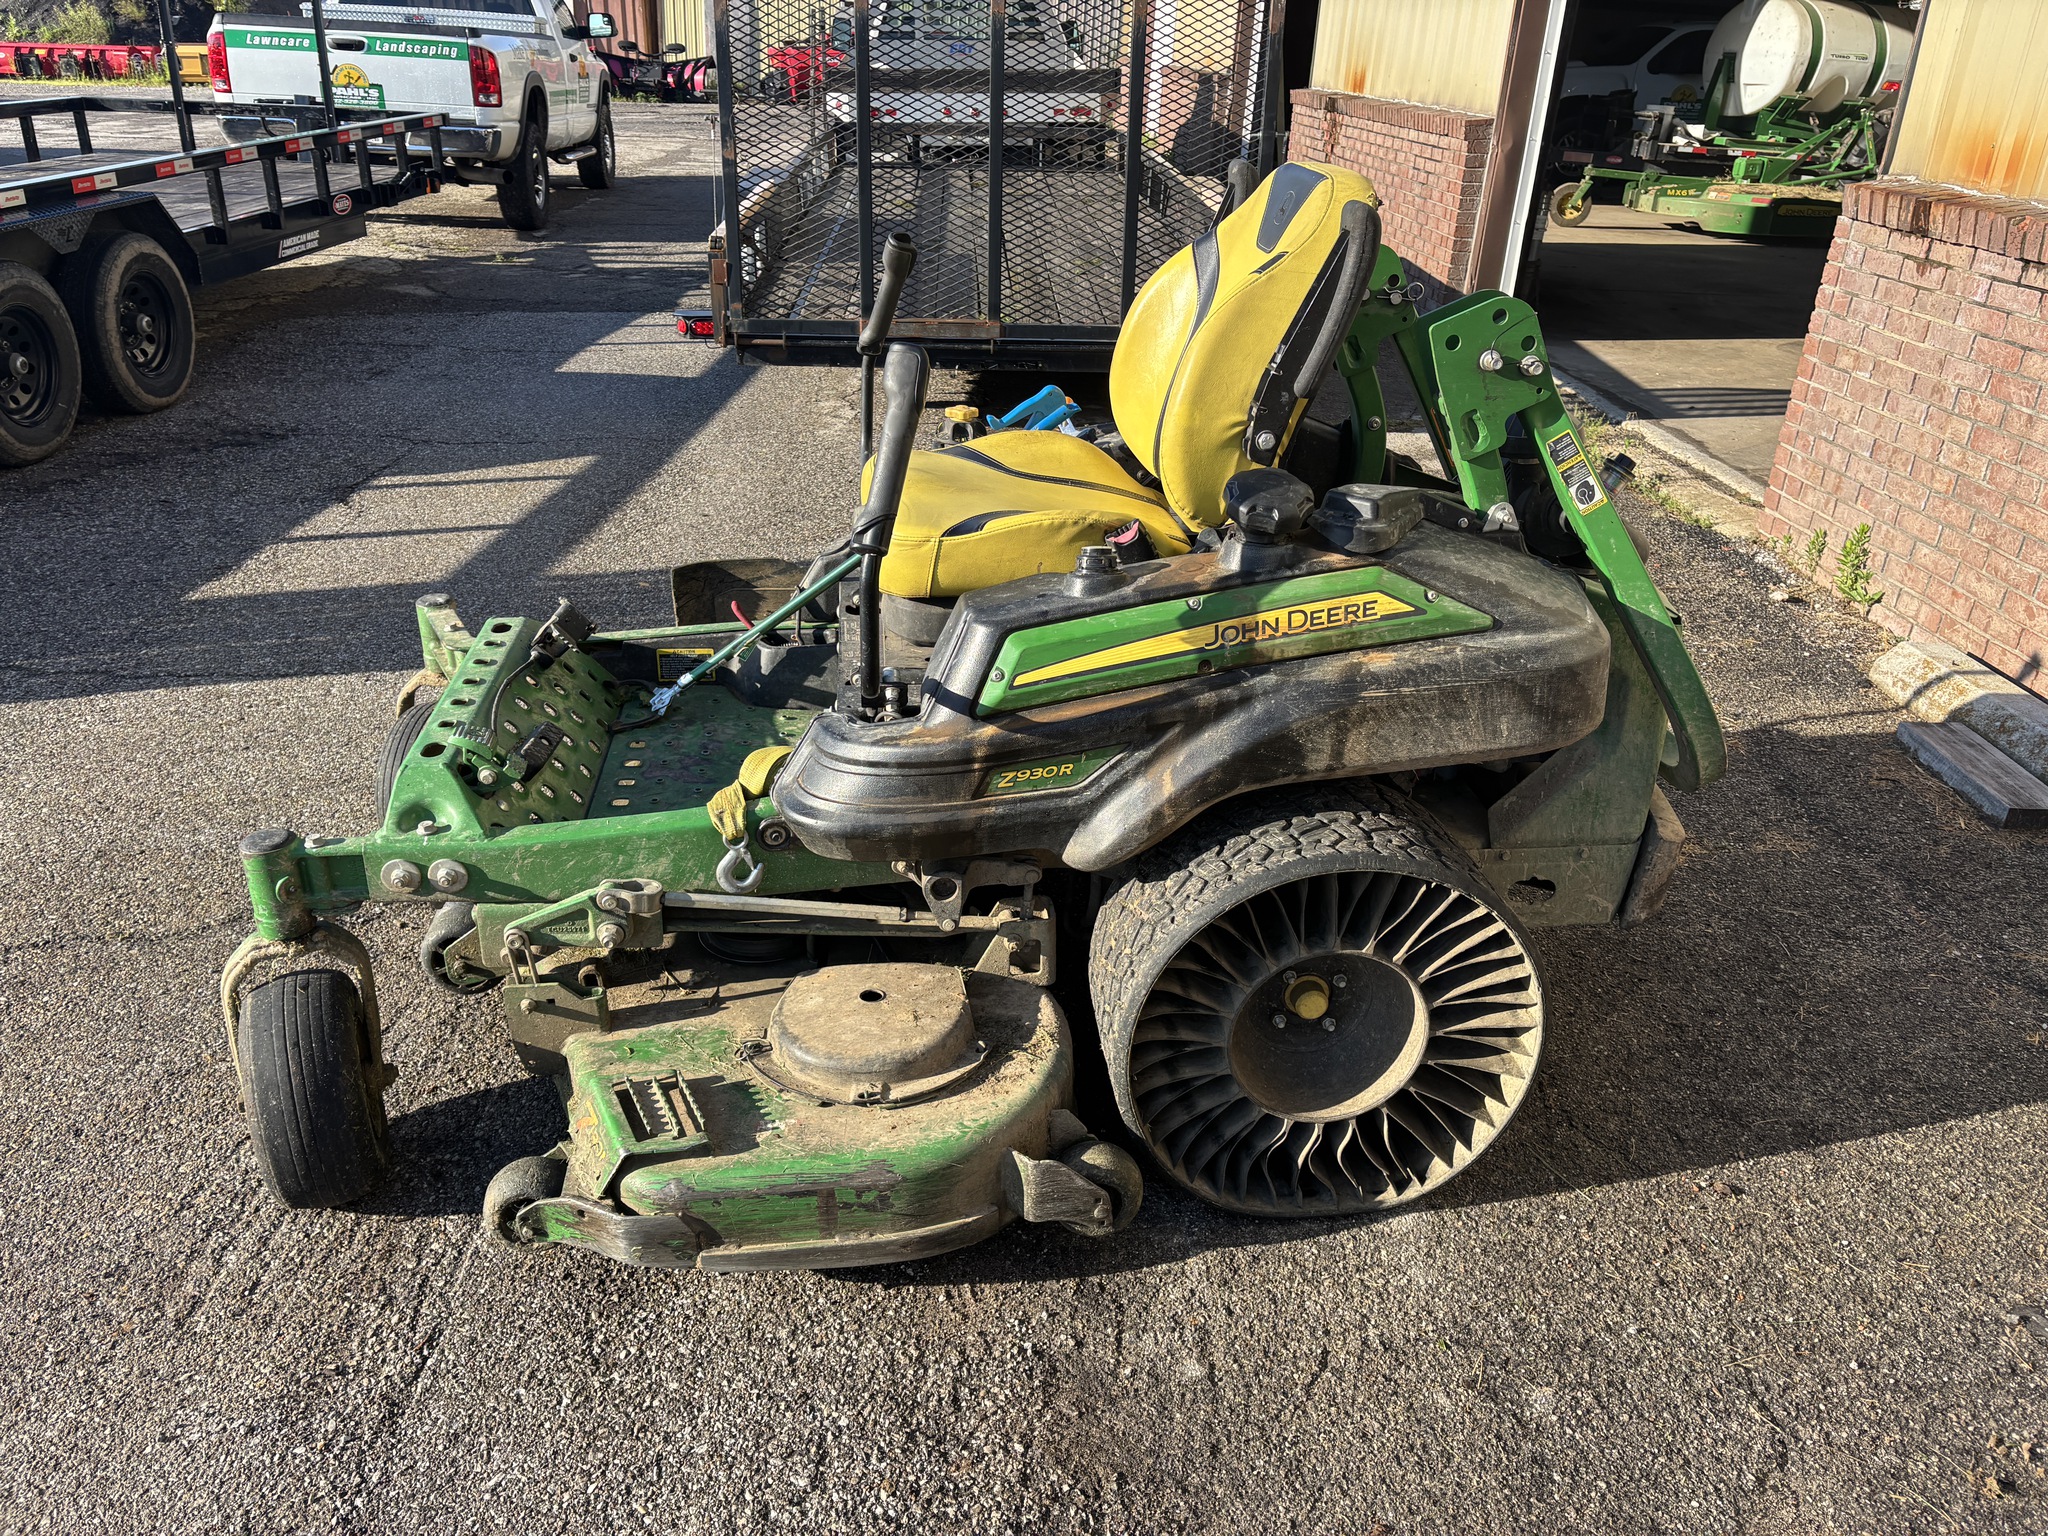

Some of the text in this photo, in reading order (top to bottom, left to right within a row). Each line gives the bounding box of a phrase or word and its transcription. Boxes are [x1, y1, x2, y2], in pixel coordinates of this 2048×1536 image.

[246, 33, 458, 58] Lawncare Landscaping
[283, 230, 319, 248] AMERICAN MADE
[1204, 600, 1378, 648] JOHN DEERE
[997, 763, 1074, 788] Z930R
